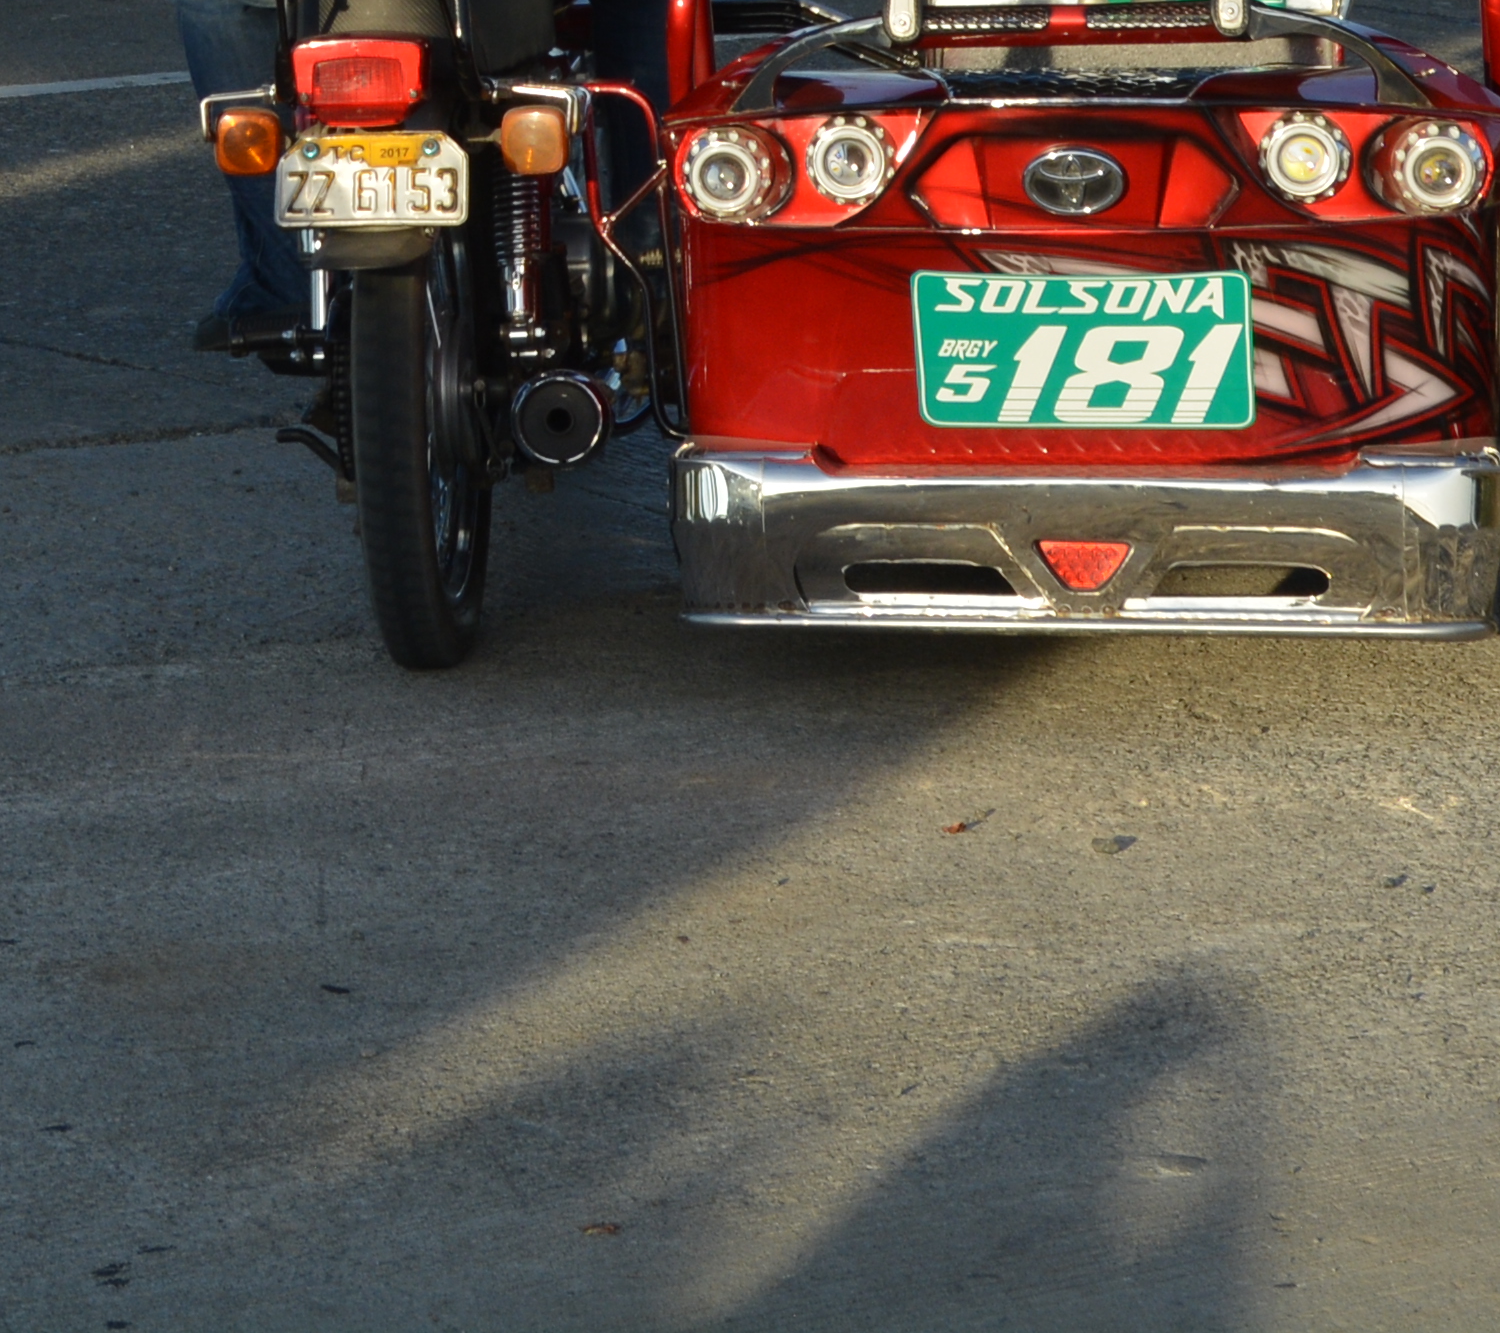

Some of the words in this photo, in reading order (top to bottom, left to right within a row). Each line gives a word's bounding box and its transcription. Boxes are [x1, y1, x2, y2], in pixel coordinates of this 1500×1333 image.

[380, 147, 410, 159] 2017
[285, 169, 336, 215] ZZ
[352, 167, 459, 215] 6153
[934, 278, 1225, 321] SOLSONA
[938, 339, 998, 360] BRGY
[935, 364, 997, 403] 5
[998, 324, 1243, 423] 181
